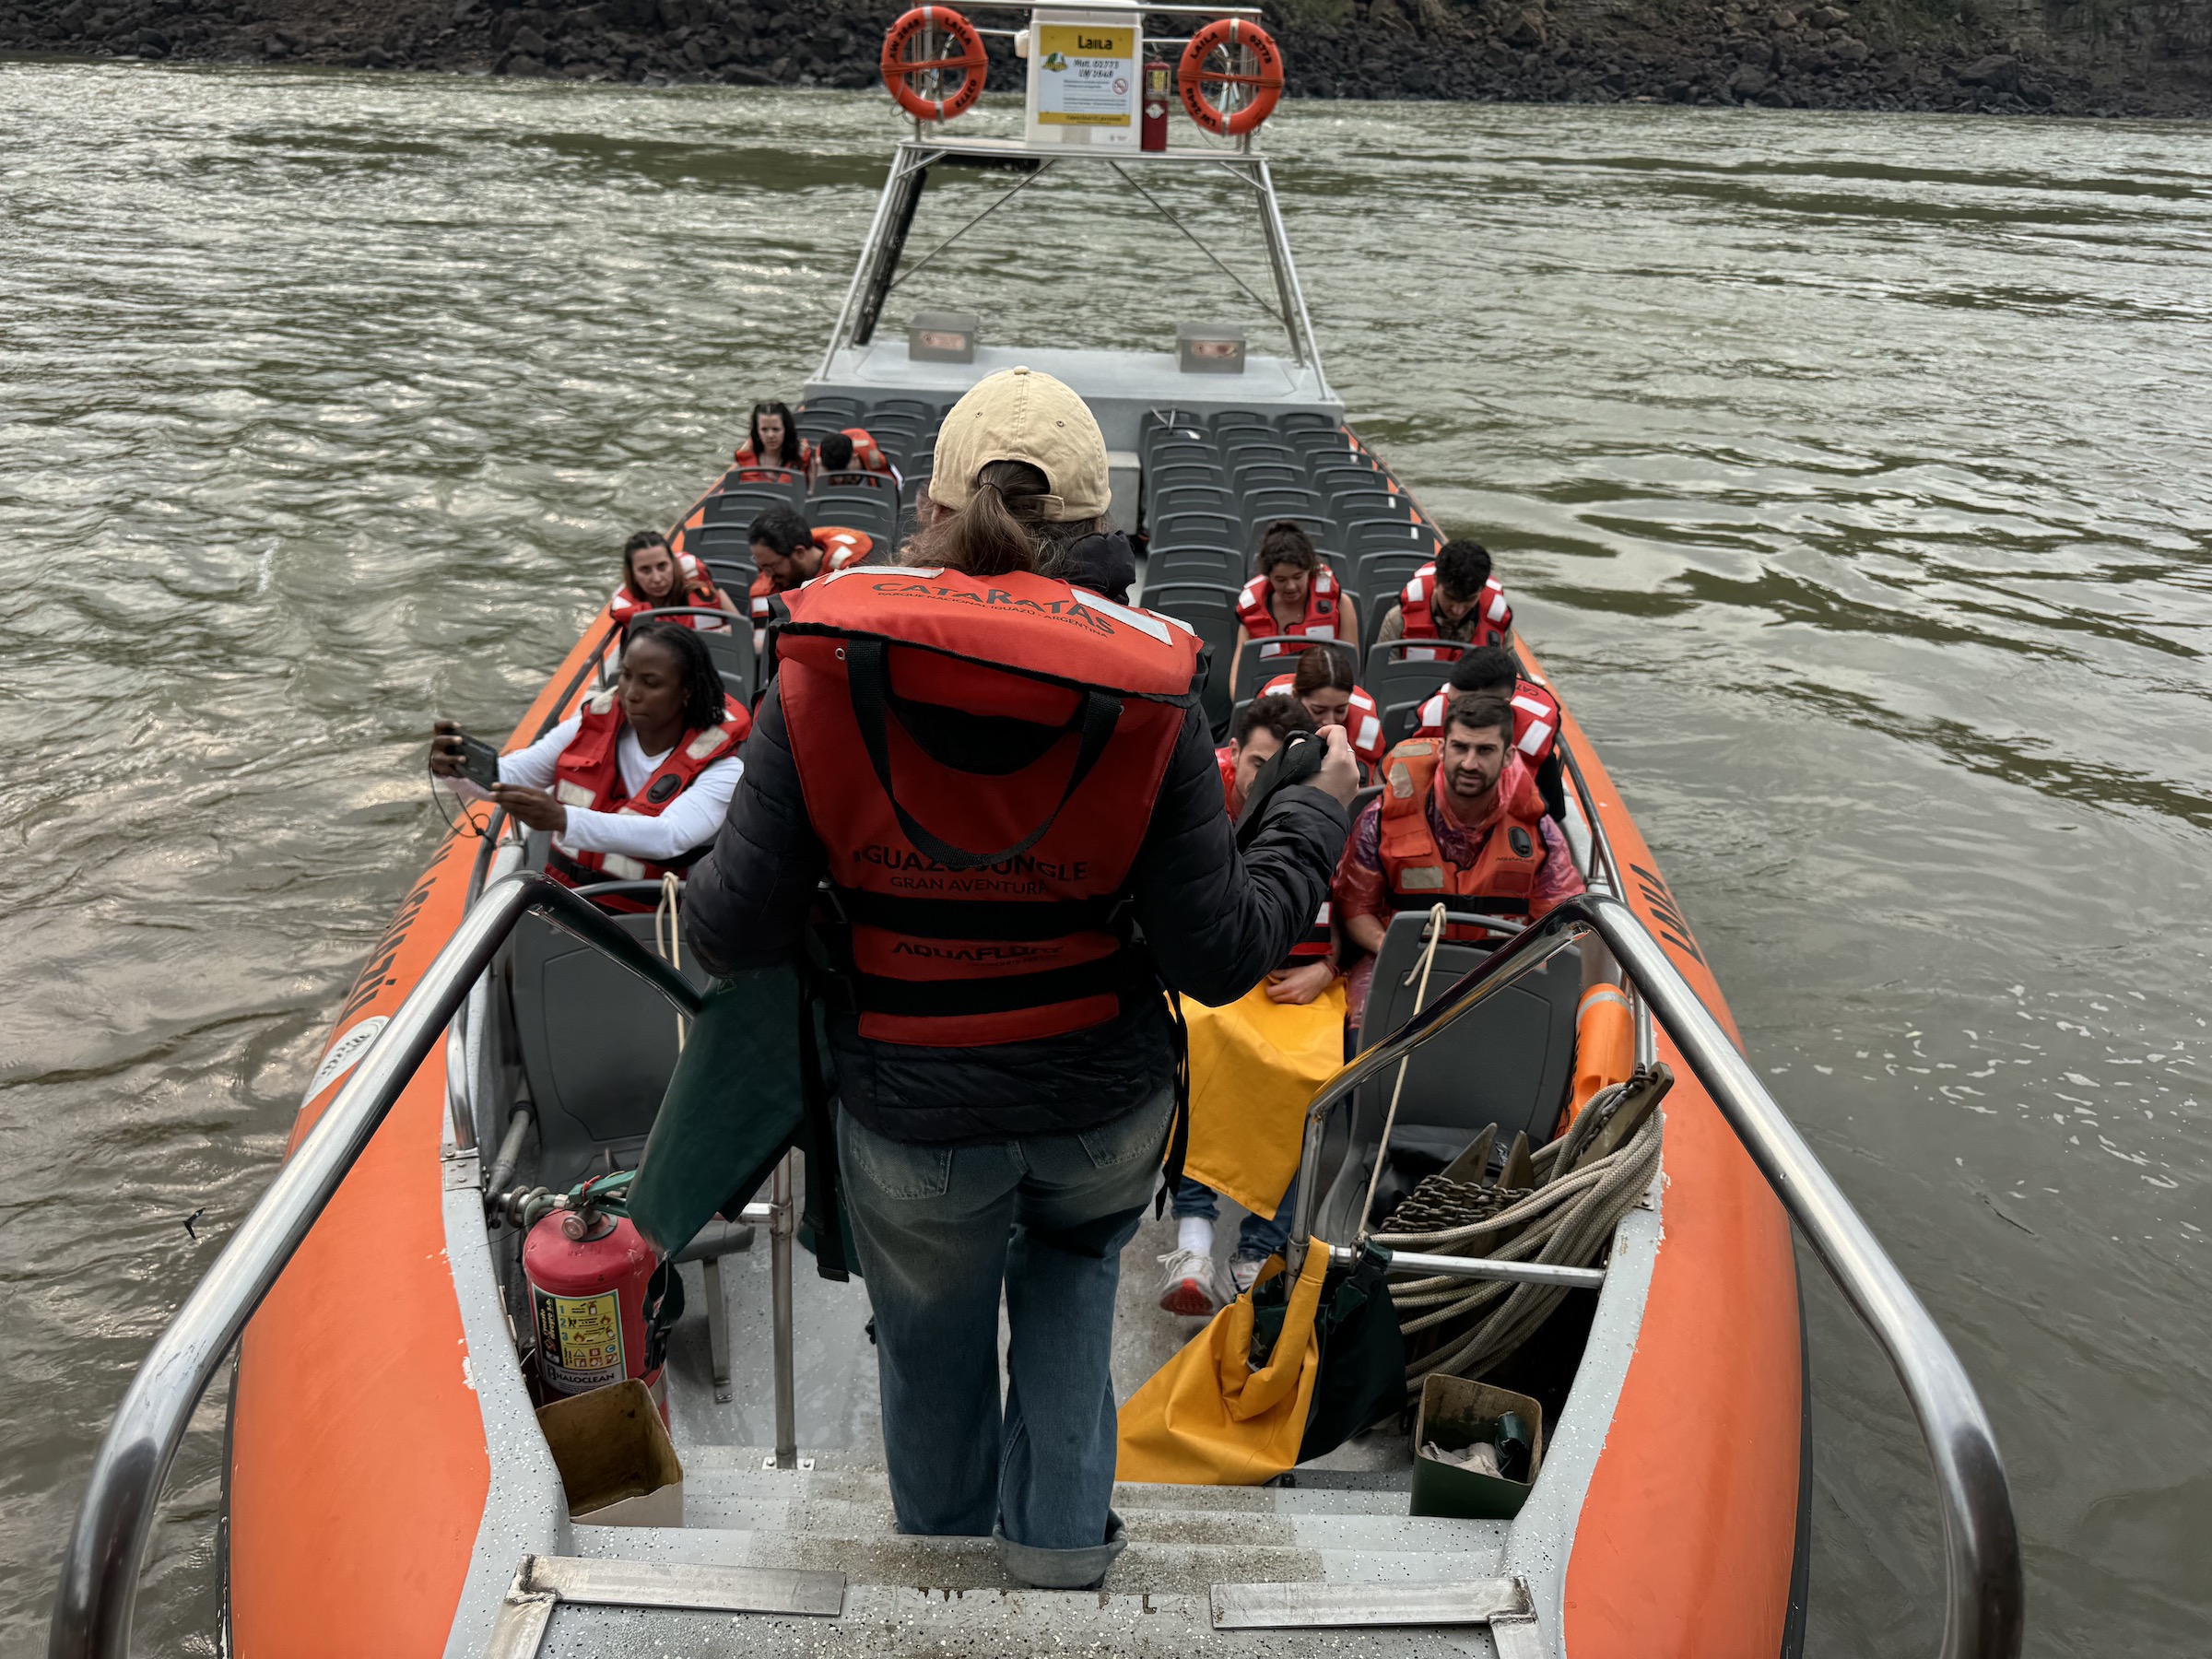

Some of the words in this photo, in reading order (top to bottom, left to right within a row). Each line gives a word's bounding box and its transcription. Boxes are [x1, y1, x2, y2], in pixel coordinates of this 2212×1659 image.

[945, 18, 972, 46] LAILA
[1190, 32, 1218, 59] LAILA
[1249, 35, 1272, 64] 02773
[926, 595, 988, 609] NACIONAL
[1043, 613, 1109, 640] ARGENTINA
[889, 876, 944, 890] GRAN
[948, 878, 1048, 895] AVENTURA
[556, 1372, 616, 1383] HALOCLEAN
